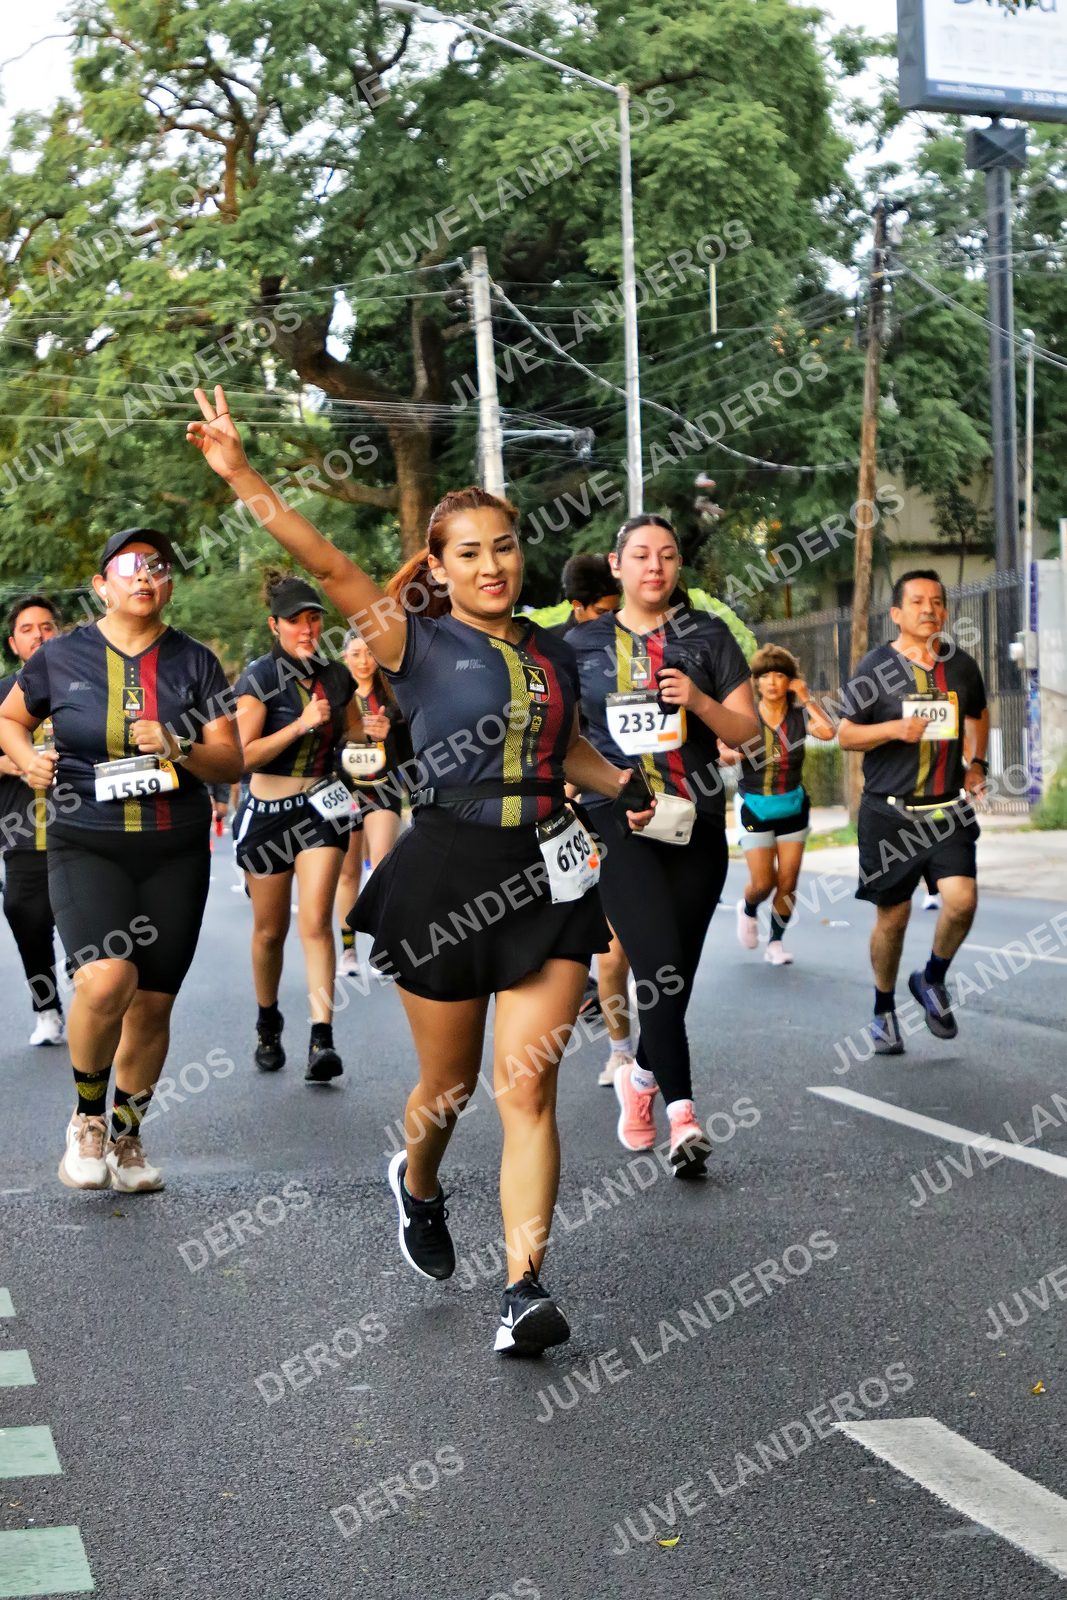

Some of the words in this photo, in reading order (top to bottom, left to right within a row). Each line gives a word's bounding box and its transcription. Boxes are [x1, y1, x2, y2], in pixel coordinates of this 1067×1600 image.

[619, 711, 668, 734] 2337
[349, 753, 376, 764] 6814
[108, 778, 161, 800] 1559
[322, 786, 350, 809] 6565
[557, 830, 591, 873] 6198
